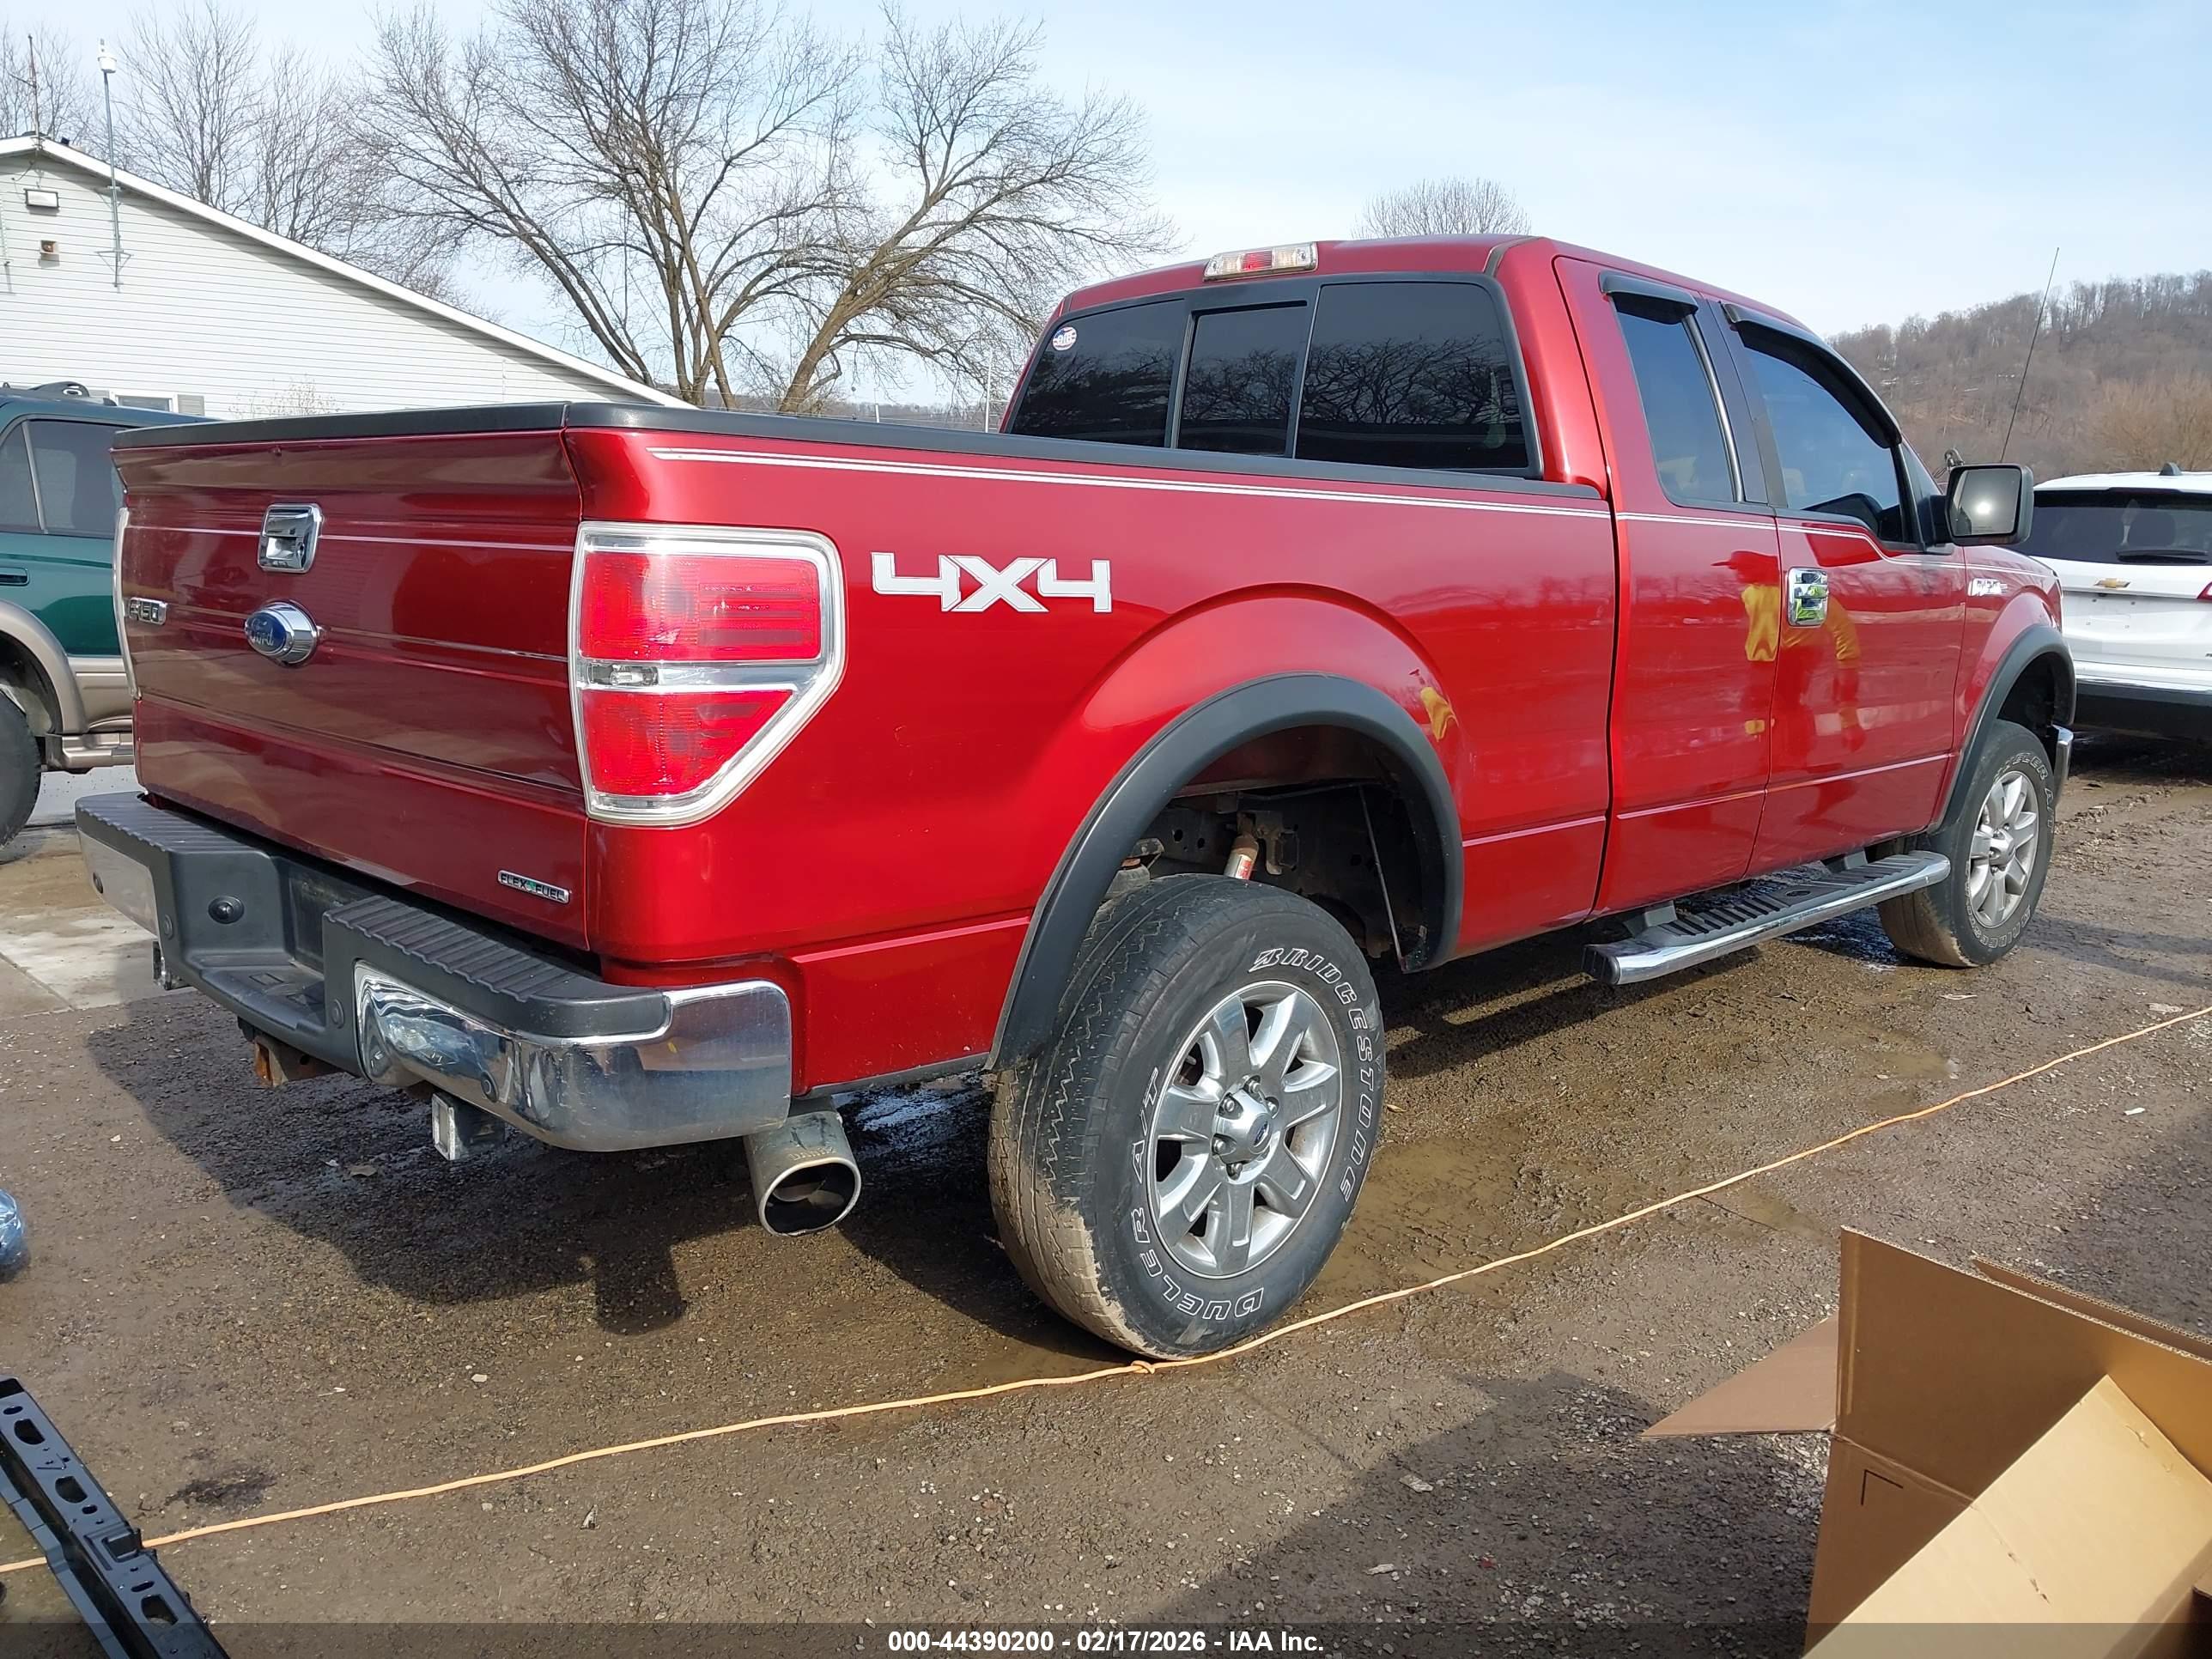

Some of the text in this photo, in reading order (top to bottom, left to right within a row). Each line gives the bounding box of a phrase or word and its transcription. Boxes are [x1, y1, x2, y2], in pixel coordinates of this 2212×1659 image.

[871, 552, 1112, 612] 4X4
[501, 872, 565, 902] FLEX FUEL
[1249, 947, 1375, 1202] BRIDGESTONE
[1130, 1066, 1265, 1321] DUELER A/T
